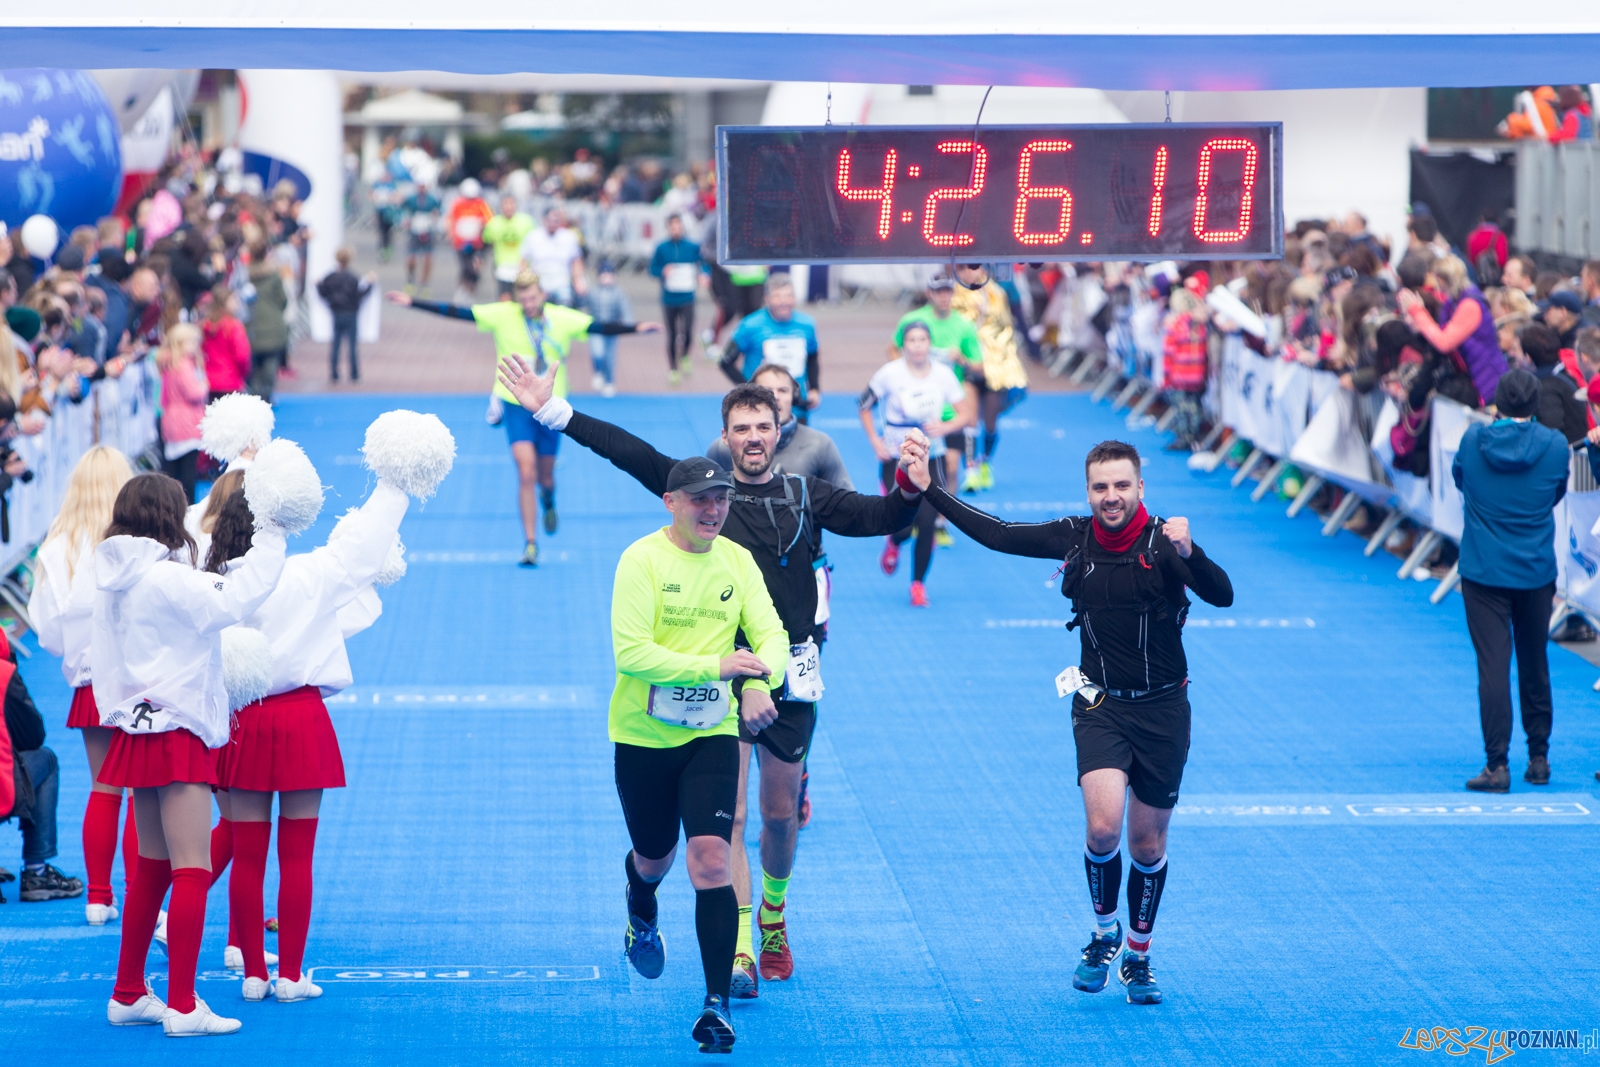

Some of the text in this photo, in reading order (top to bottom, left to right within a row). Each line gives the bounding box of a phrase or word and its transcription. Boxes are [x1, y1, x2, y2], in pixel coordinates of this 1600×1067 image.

[663, 604, 691, 616] WANT
[672, 686, 720, 702] 3230
[1371, 805, 1483, 814] PKO
[334, 970, 470, 979] PKO
